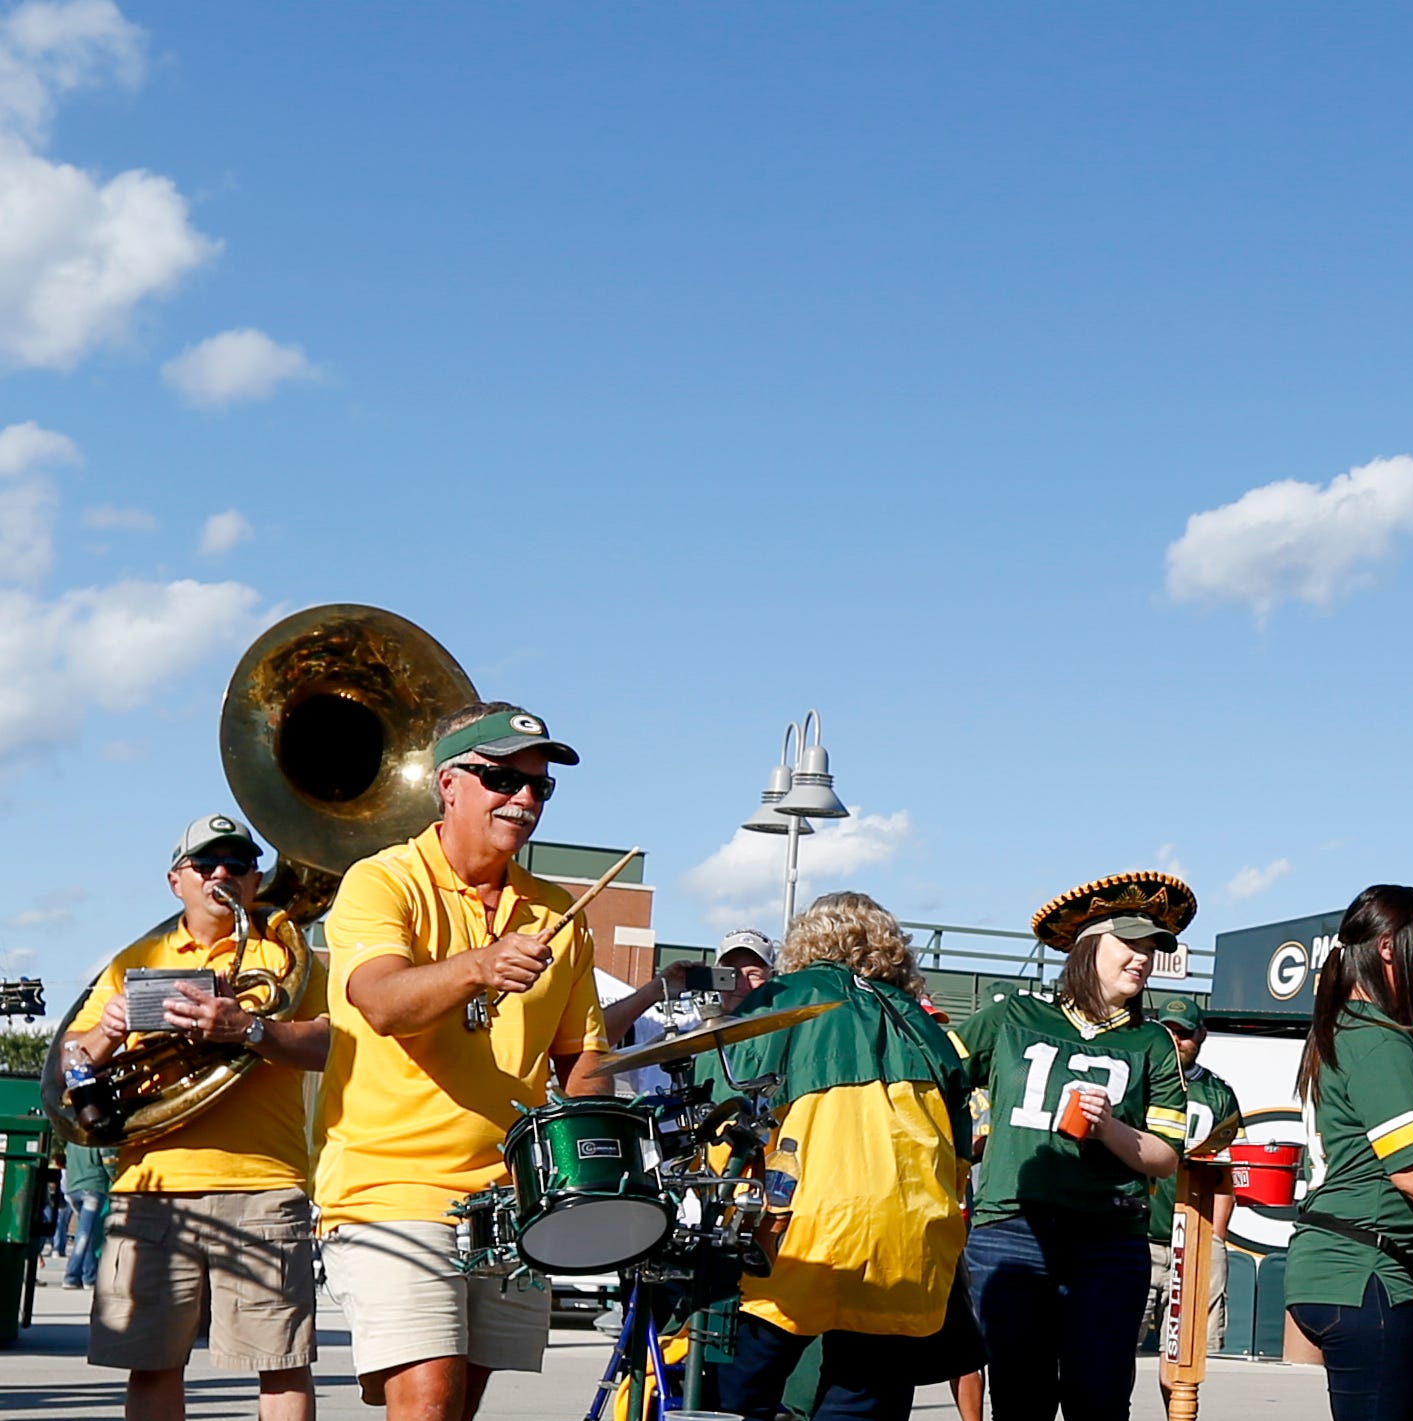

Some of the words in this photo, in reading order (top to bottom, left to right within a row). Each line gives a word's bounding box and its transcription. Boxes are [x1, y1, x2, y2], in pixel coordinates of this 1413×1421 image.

[1010, 1042, 1130, 1133] 12
[1170, 1253, 1184, 1306] LIFT
[1168, 1316, 1180, 1357] SKI
